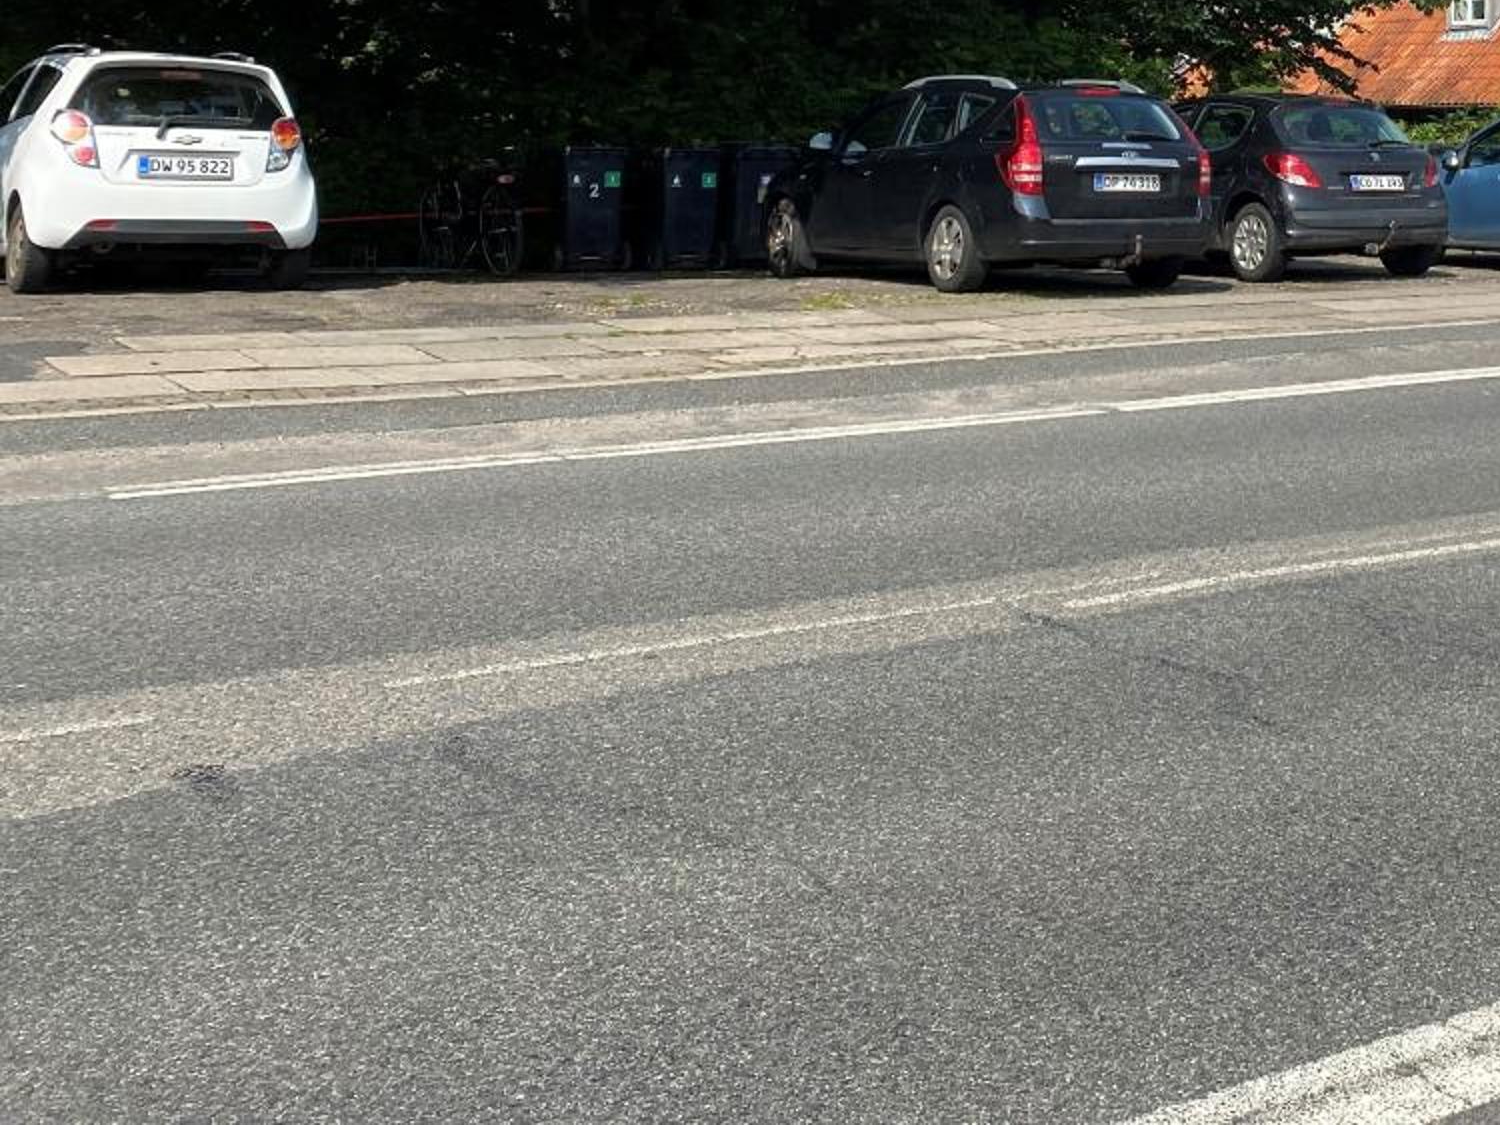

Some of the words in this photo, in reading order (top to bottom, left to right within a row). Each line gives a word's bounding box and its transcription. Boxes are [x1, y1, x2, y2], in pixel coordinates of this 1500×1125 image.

[150, 156, 173, 173] DW
[177, 156, 196, 173] 95
[199, 157, 229, 174] 822
[588, 183, 600, 199] 2
